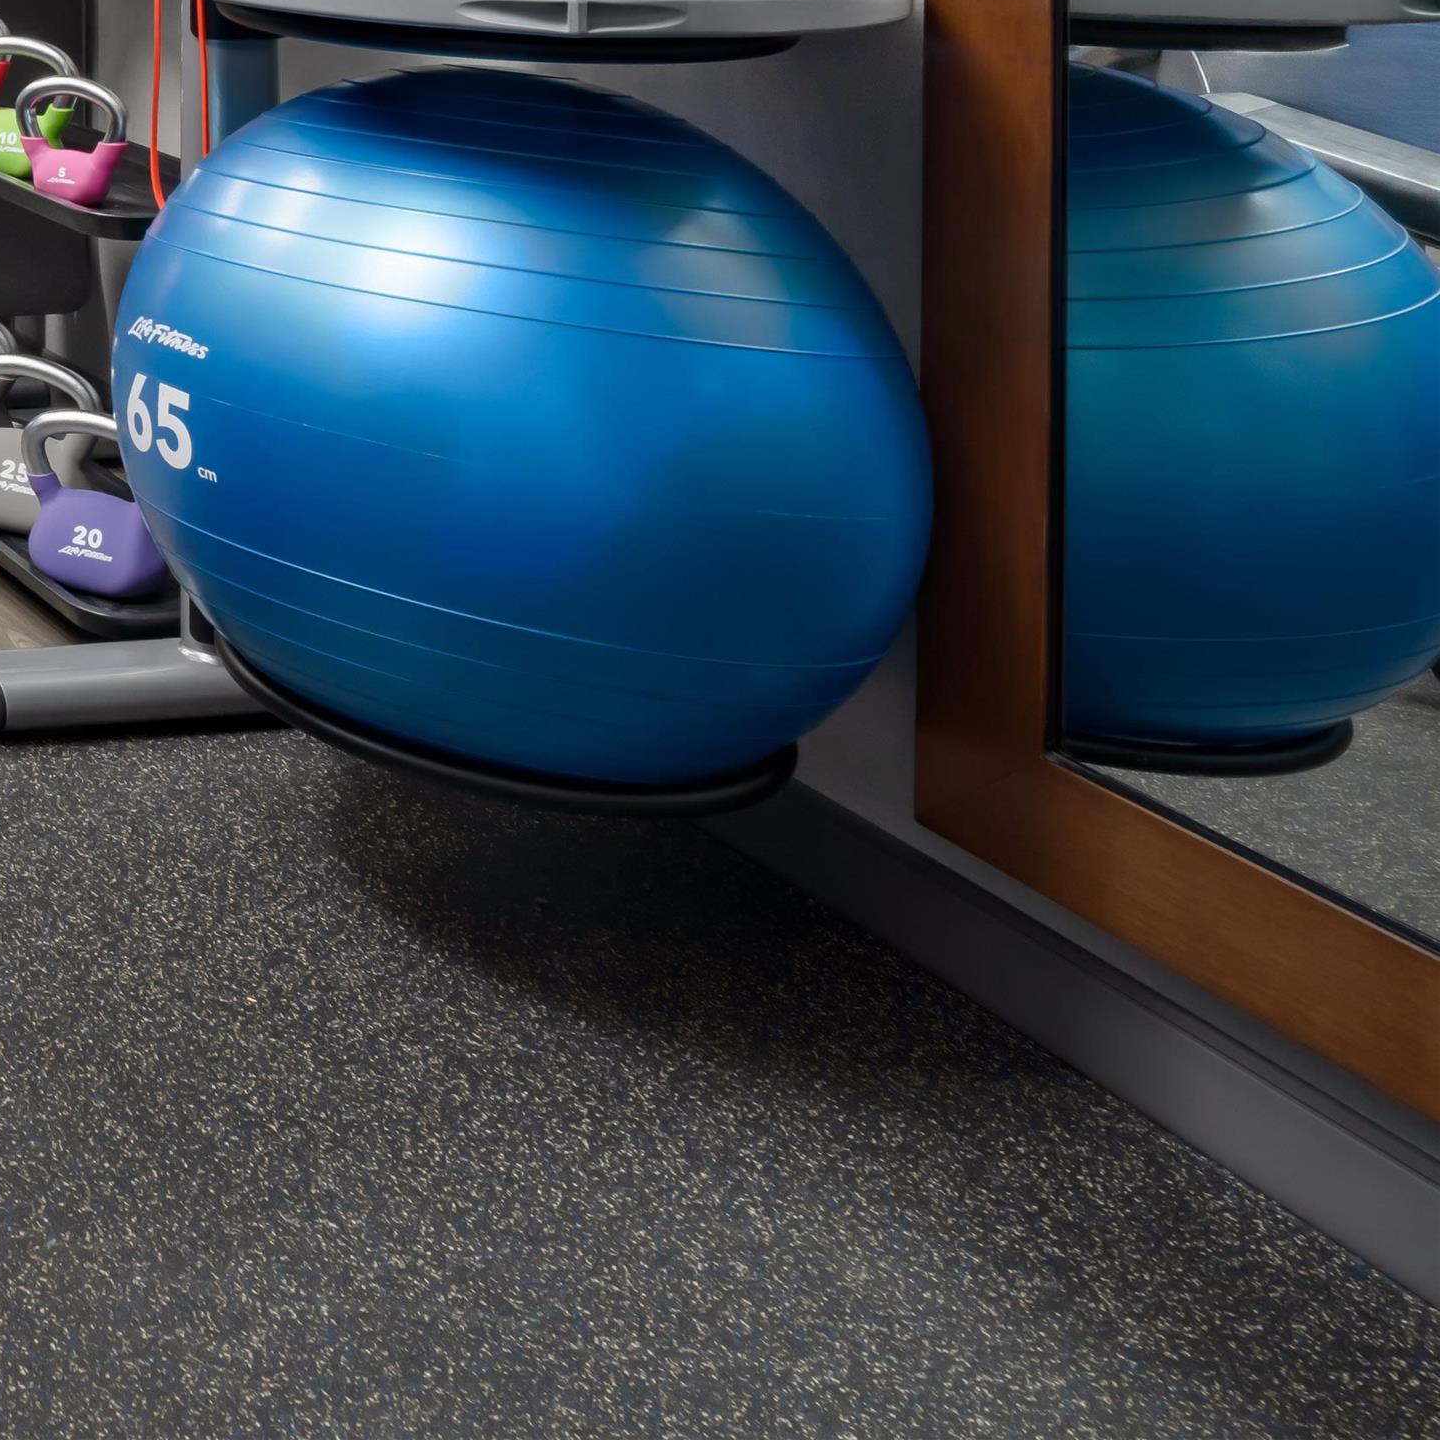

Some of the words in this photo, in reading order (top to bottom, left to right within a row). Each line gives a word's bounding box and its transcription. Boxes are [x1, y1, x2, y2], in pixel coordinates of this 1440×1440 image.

[0, 131, 18, 145] 10
[57, 166, 67, 178] 5
[0, 459, 30, 484] 25
[72, 525, 103, 549] 20
